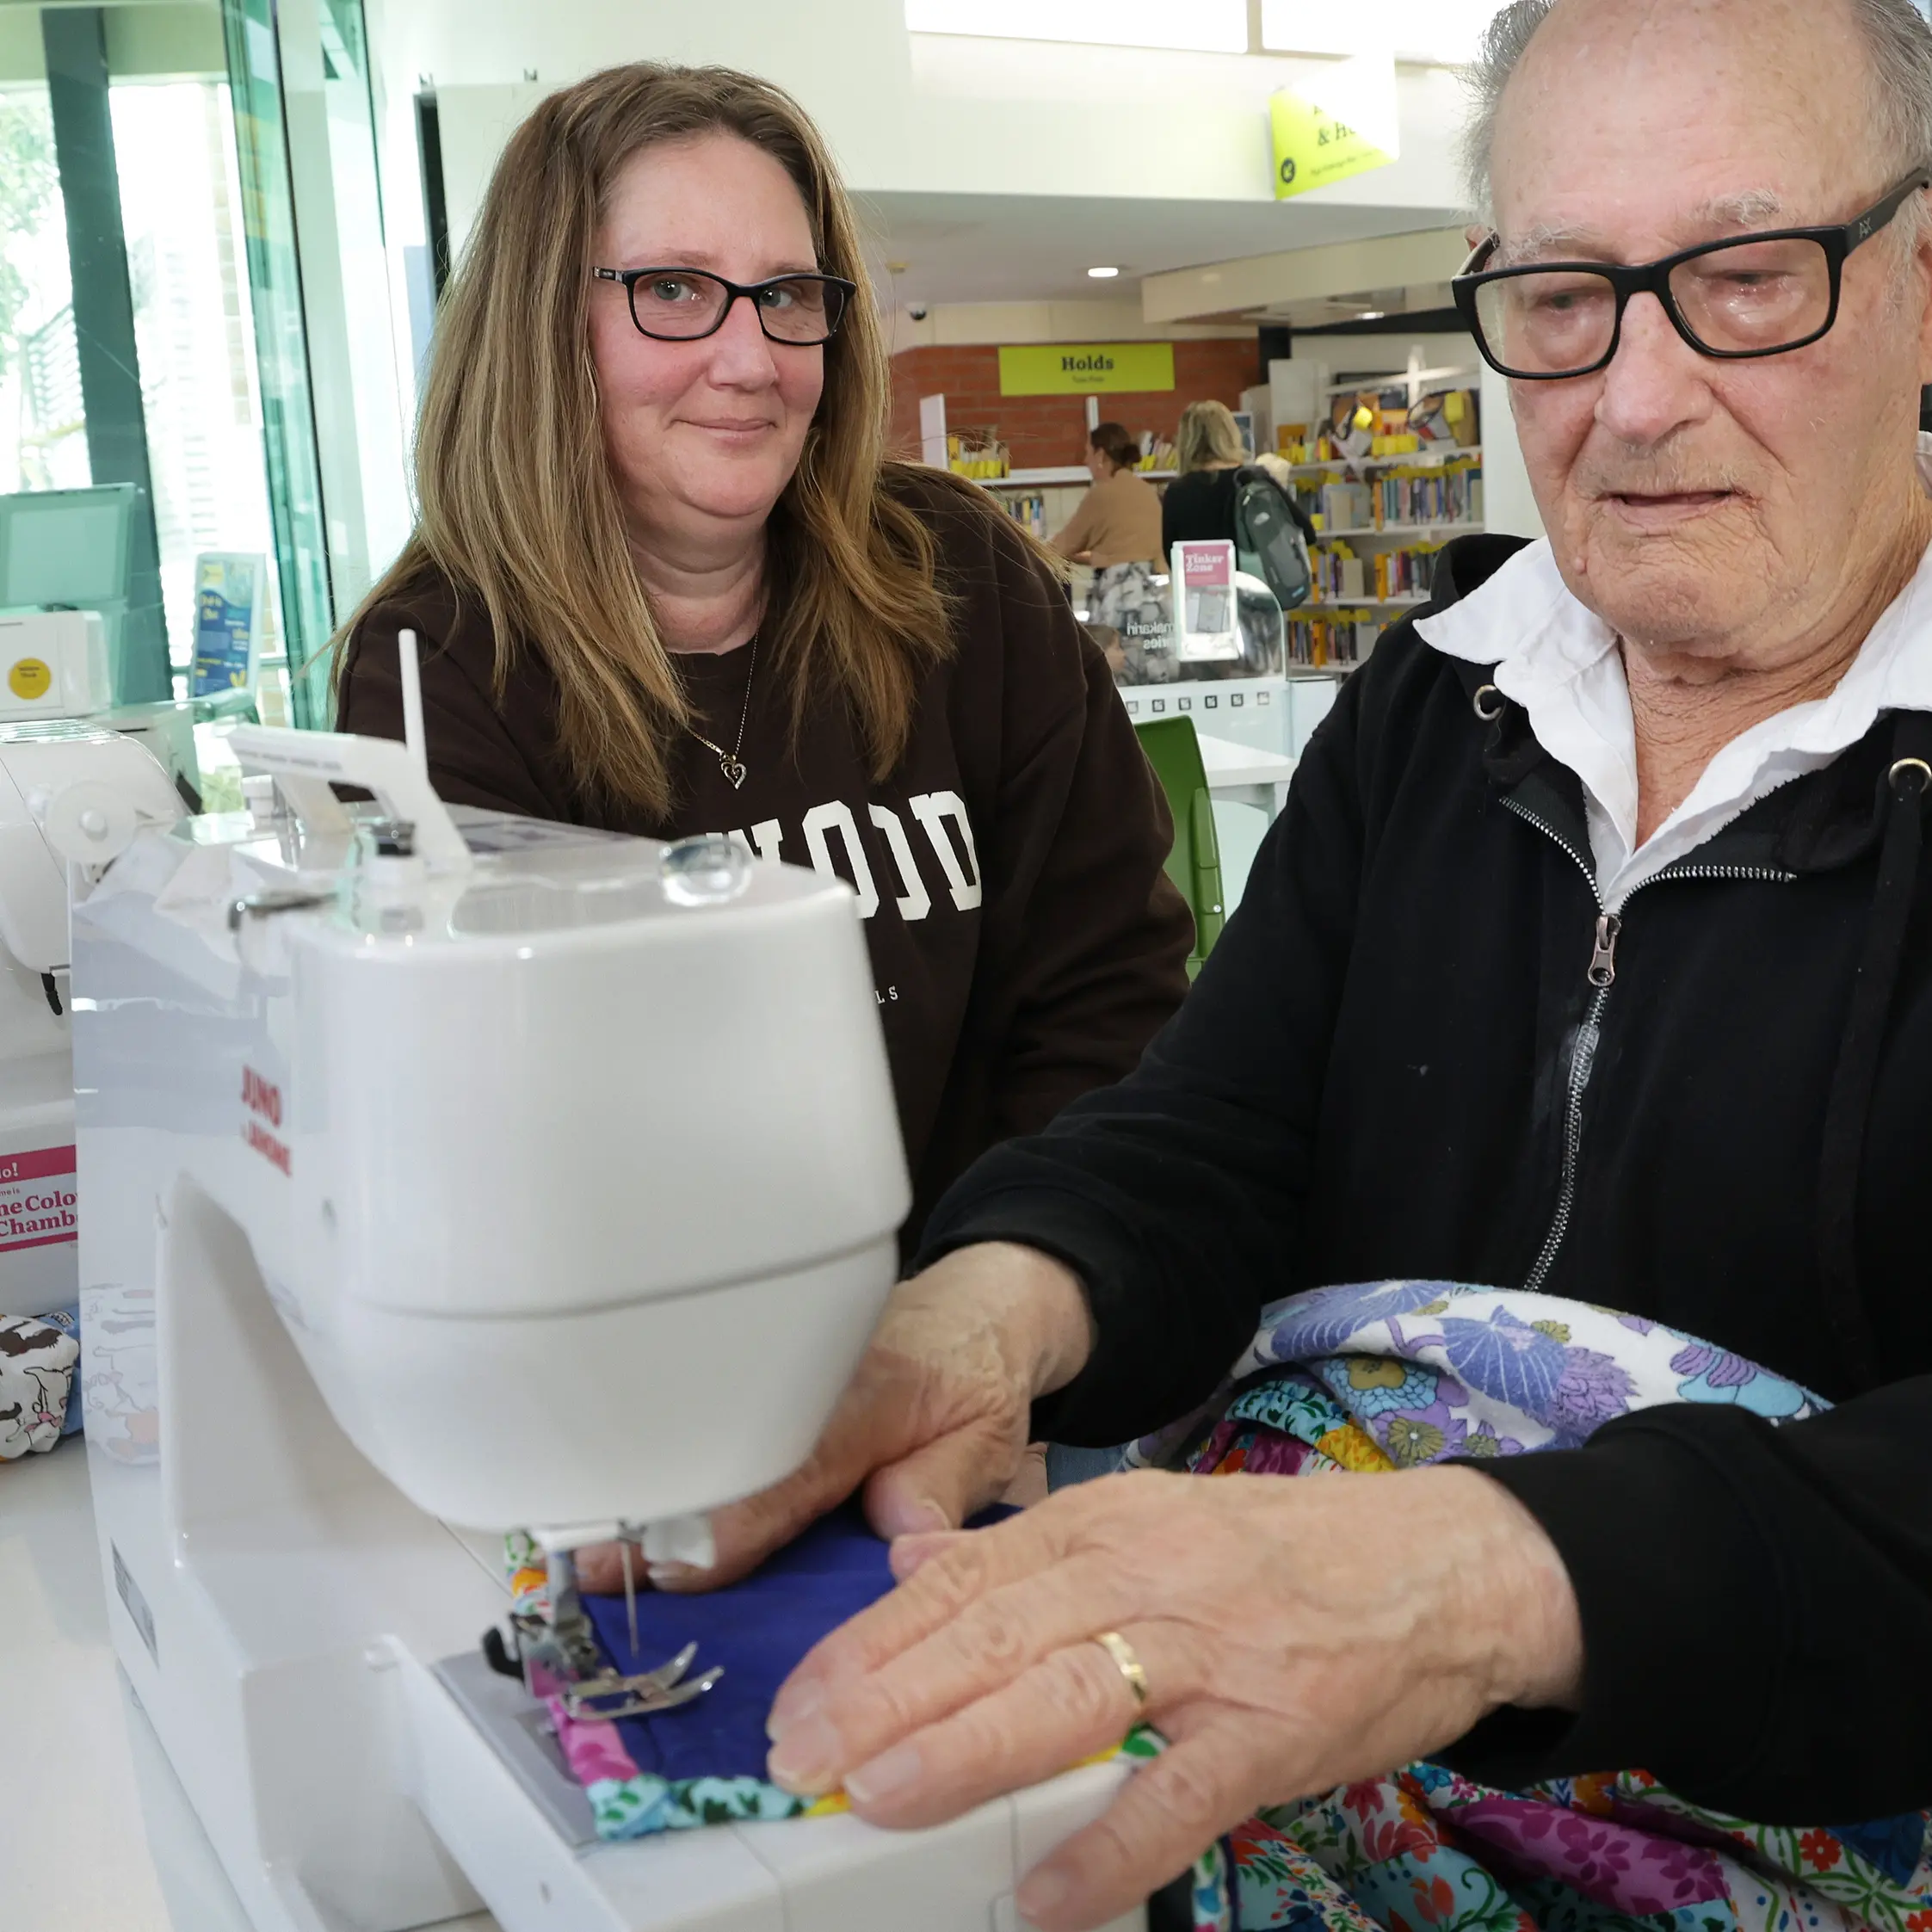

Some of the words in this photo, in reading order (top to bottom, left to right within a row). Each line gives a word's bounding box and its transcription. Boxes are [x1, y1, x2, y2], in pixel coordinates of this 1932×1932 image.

[1061, 354, 1114, 372] Holds
[1185, 553, 1225, 564] Tinker
[1186, 564, 1213, 572] Zone
[874, 985, 898, 1004] LS
[0, 1162, 19, 1178] o!
[25, 1190, 77, 1212] Colo
[0, 1209, 77, 1237] Chamb
